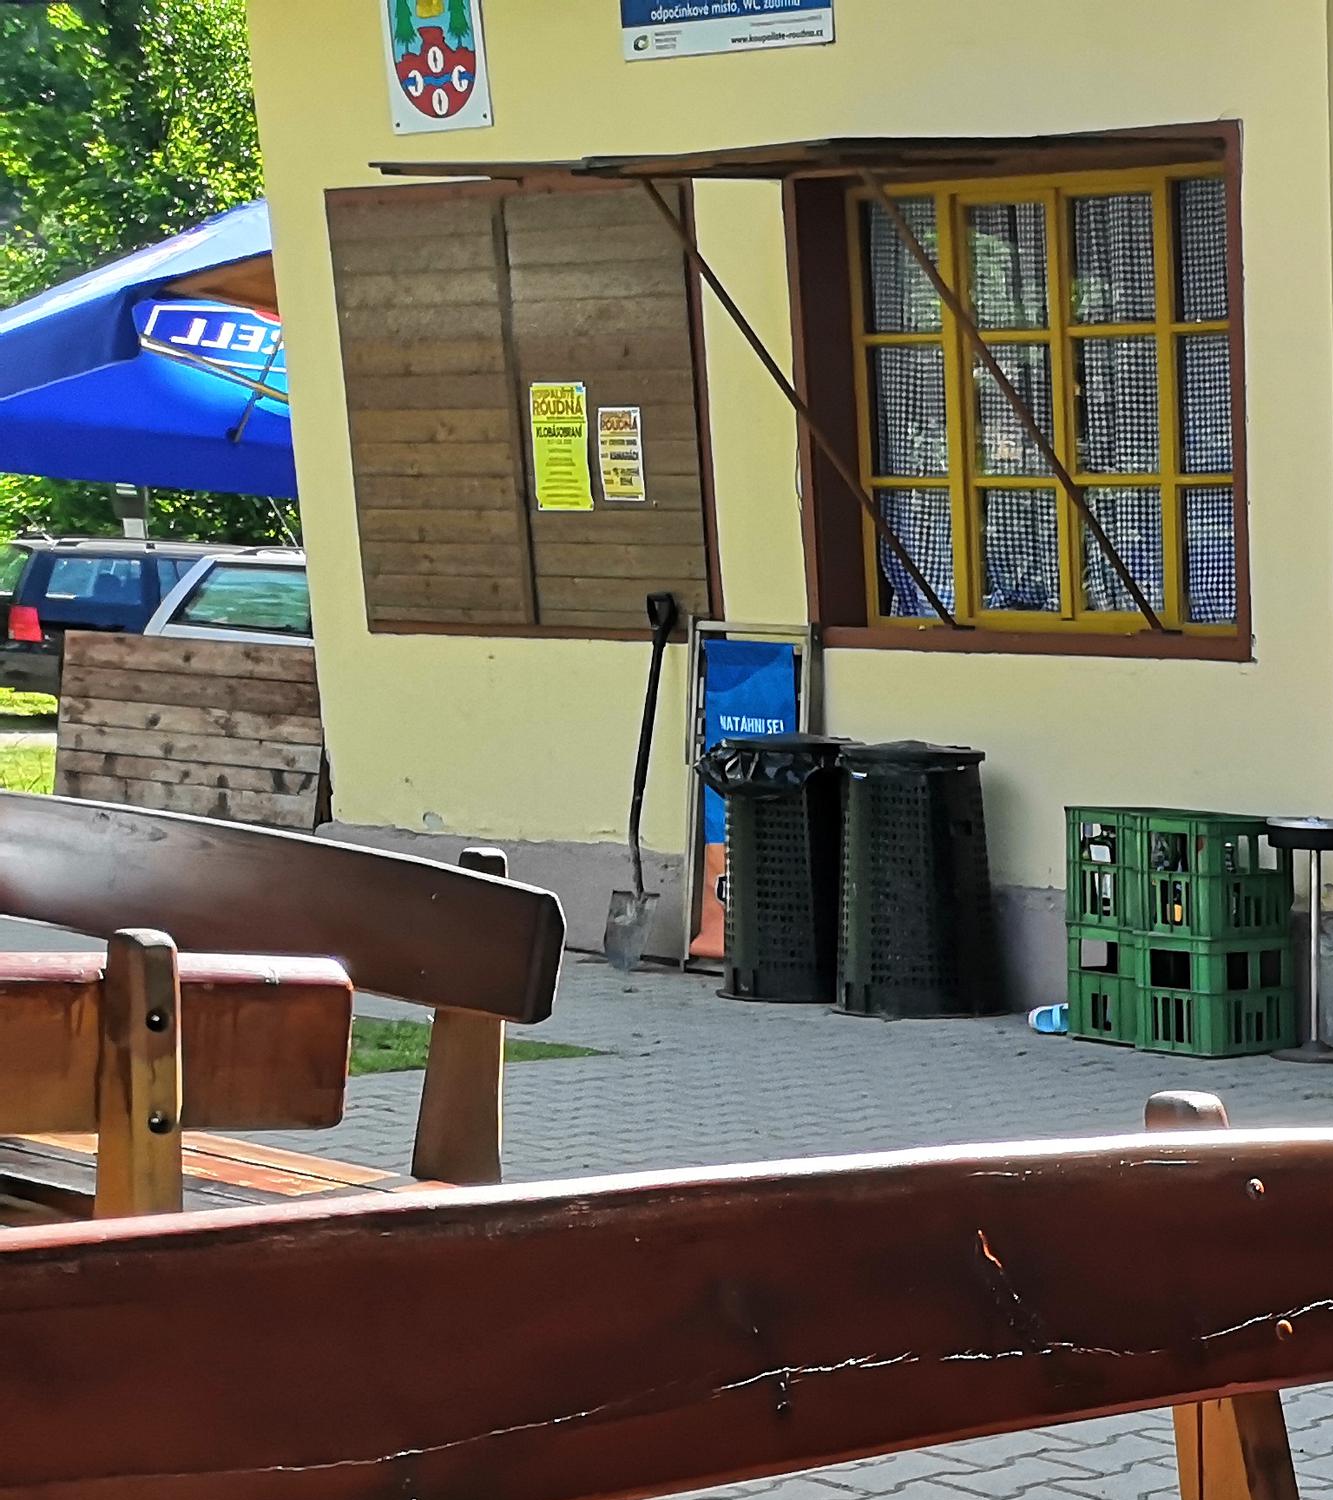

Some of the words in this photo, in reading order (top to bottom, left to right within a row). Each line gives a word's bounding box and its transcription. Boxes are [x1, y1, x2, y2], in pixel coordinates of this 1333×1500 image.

[650, 4, 709, 22] odpočinkové
[711, 1, 740, 15] místo,
[532, 396, 584, 417] ROUDNÁ
[720, 715, 766, 734] NATÁHNI
